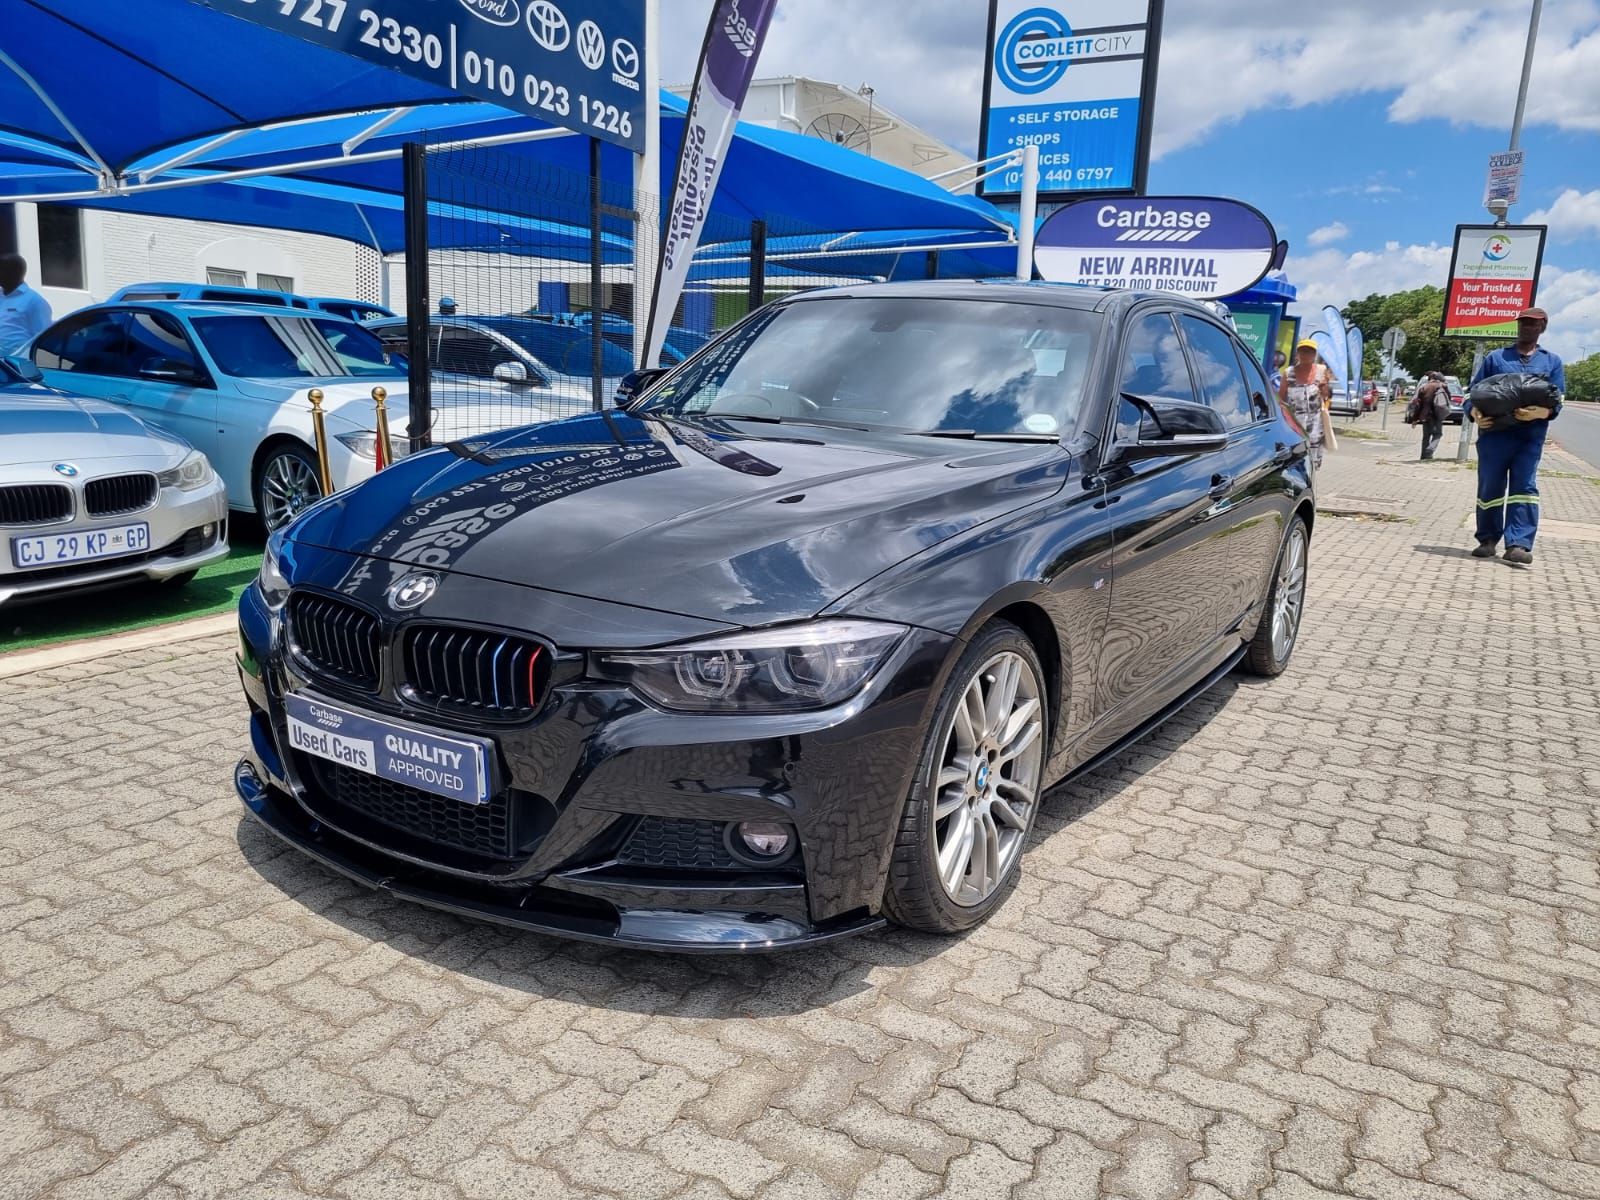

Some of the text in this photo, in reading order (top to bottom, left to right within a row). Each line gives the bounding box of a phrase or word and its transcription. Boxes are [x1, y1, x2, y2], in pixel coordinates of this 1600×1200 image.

[468, 0, 506, 17] ord
[1019, 36, 1132, 59] CORLETTCITY
[360, 9, 442, 69] 2330
[464, 51, 515, 96] 010
[524, 74, 570, 116] 023
[579, 95, 632, 138] 1226
[1017, 108, 1119, 124] SELF STORAGE
[1016, 133, 1061, 146] SHOPS
[1045, 169, 1072, 181] 440
[1077, 168, 1113, 180] 6797
[1097, 205, 1211, 228] Carbase
[1079, 257, 1218, 278] NEW ARRIVAL
[1155, 279, 1217, 292] DISCOUNT
[1463, 282, 1521, 293] Your Trusted &
[1457, 295, 1523, 307] Longest Serving
[1456, 307, 1521, 319] Local Pharmacy
[20, 528, 146, 563] CJ 29 KP GP
[310, 705, 343, 724] Carbase
[292, 724, 368, 767] Used Cars
[385, 734, 463, 769] QUALITY
[388, 759, 464, 791] APPROVED
